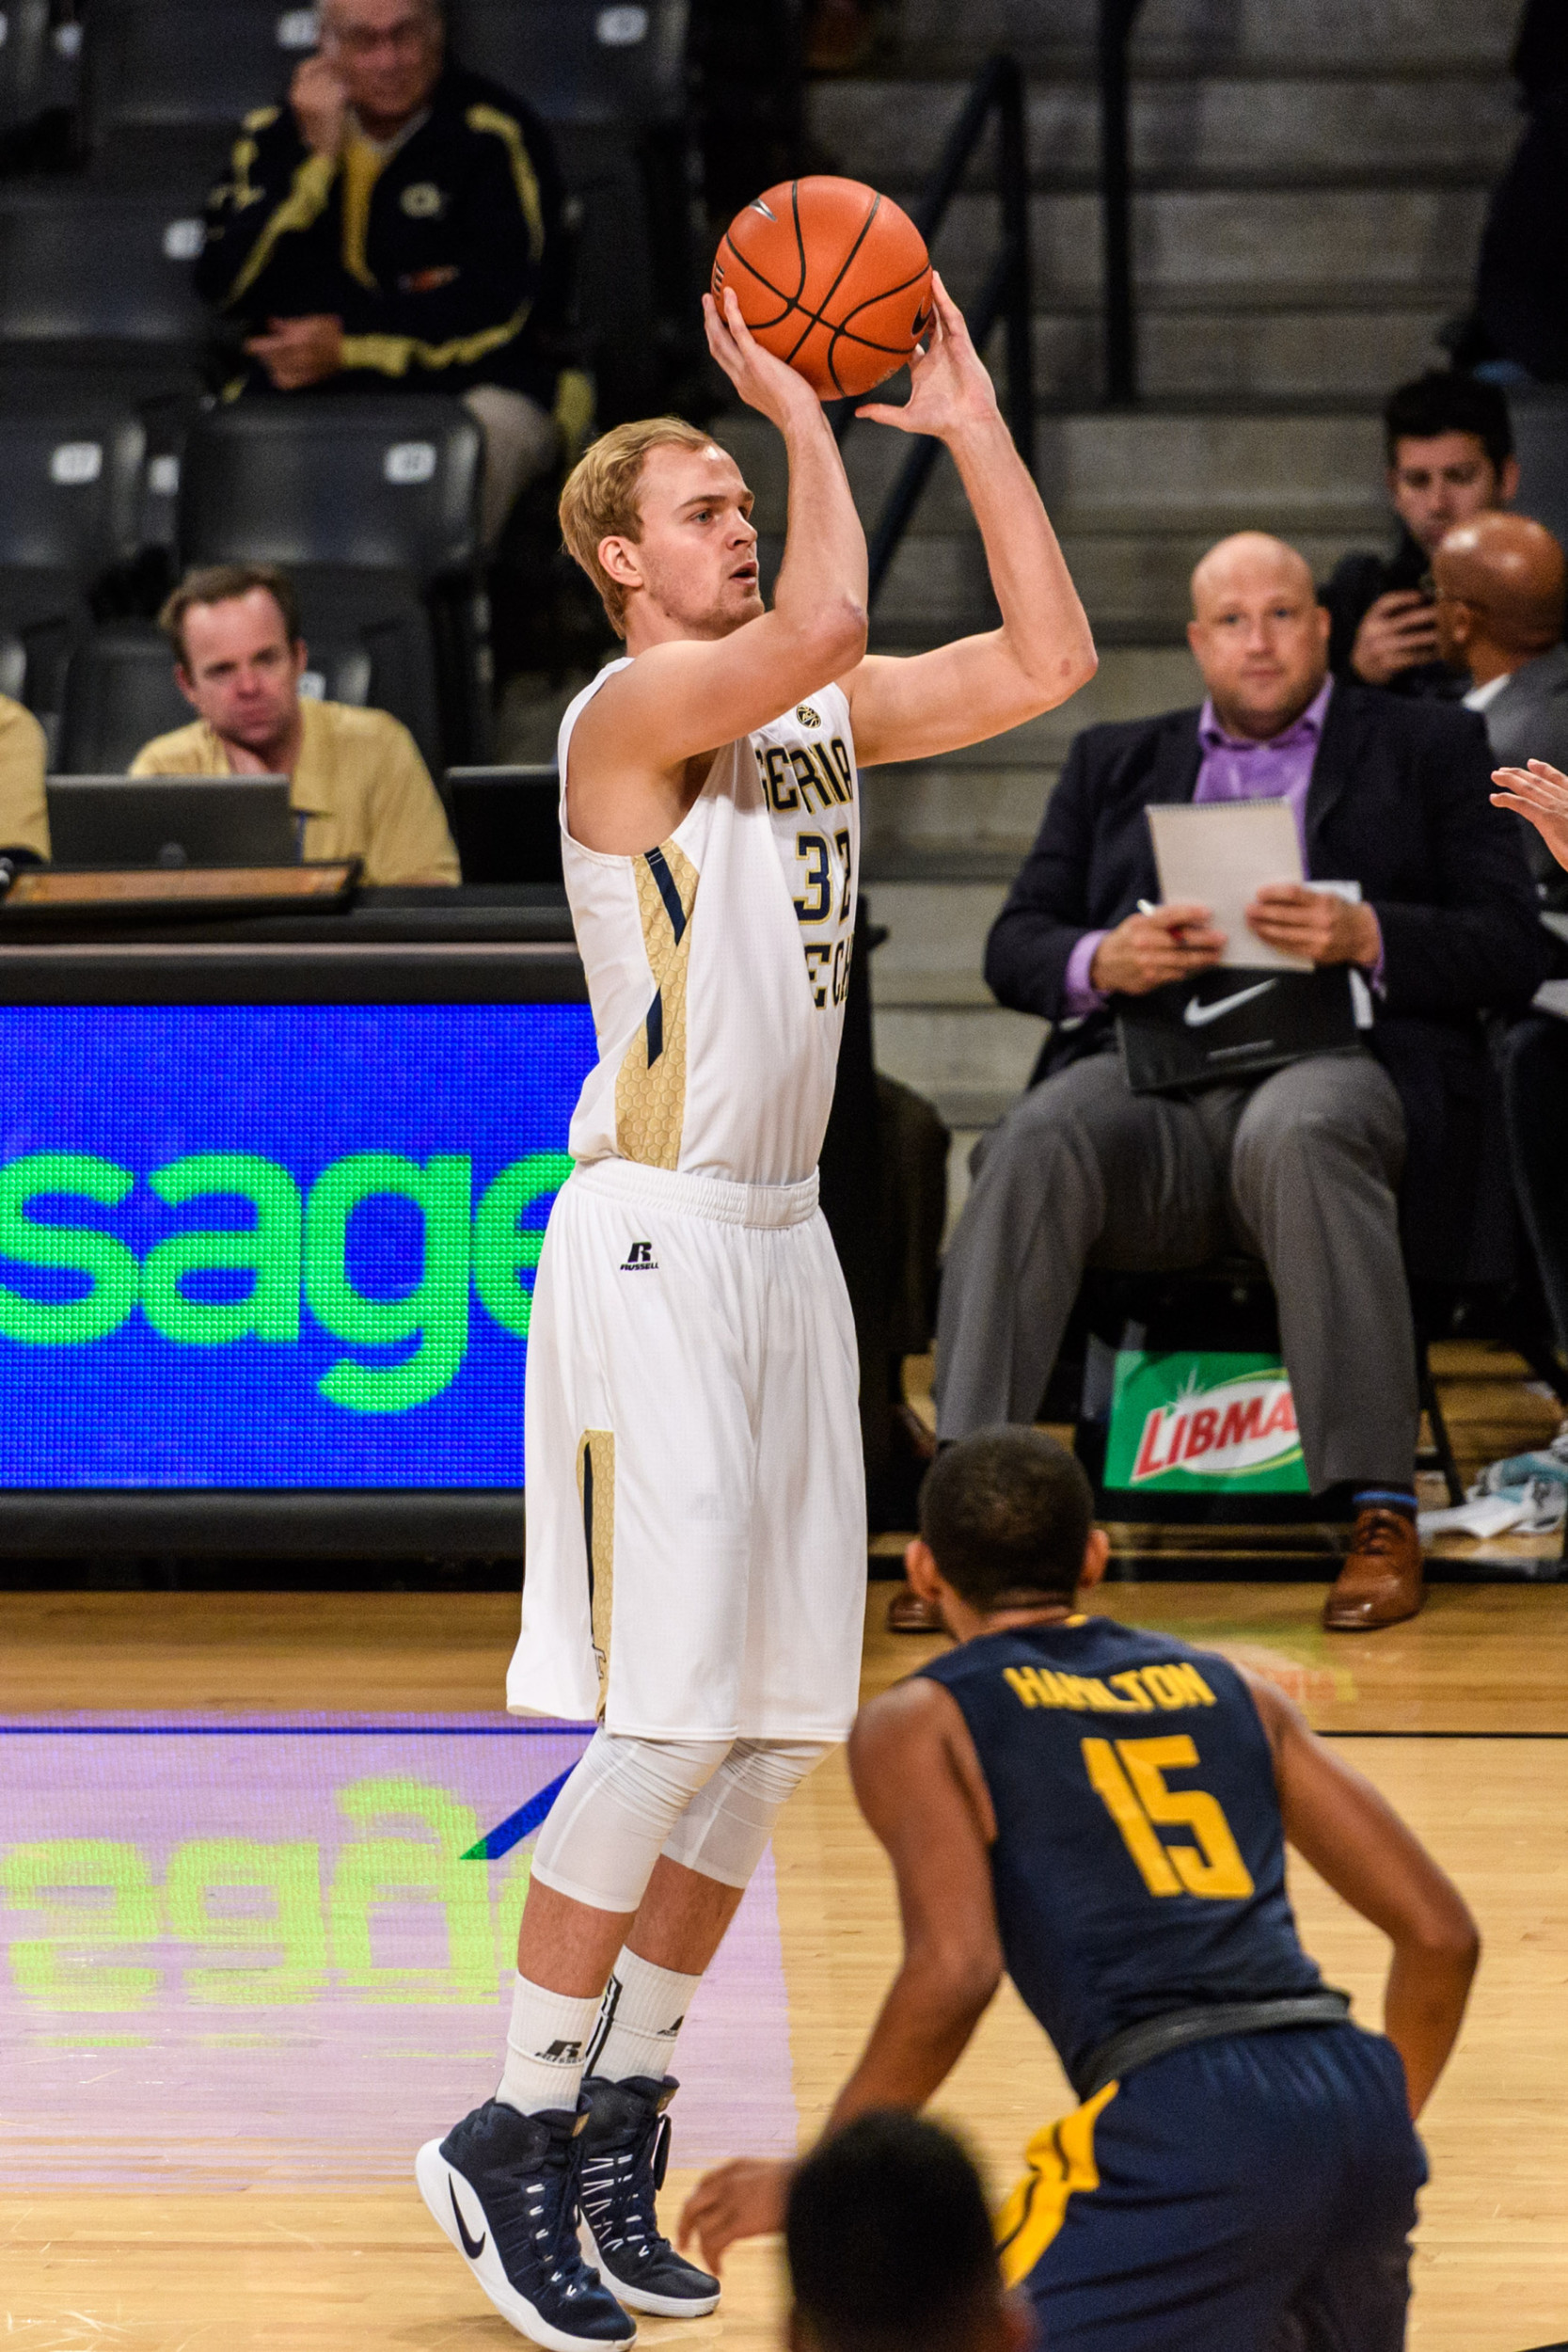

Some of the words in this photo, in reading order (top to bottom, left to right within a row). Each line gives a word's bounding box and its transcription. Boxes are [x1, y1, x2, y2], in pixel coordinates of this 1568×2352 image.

[1132, 1391, 1299, 1479] LIBMA
[1003, 1661, 1217, 1712] HAMILTON
[1081, 1734, 1255, 1899] 15
